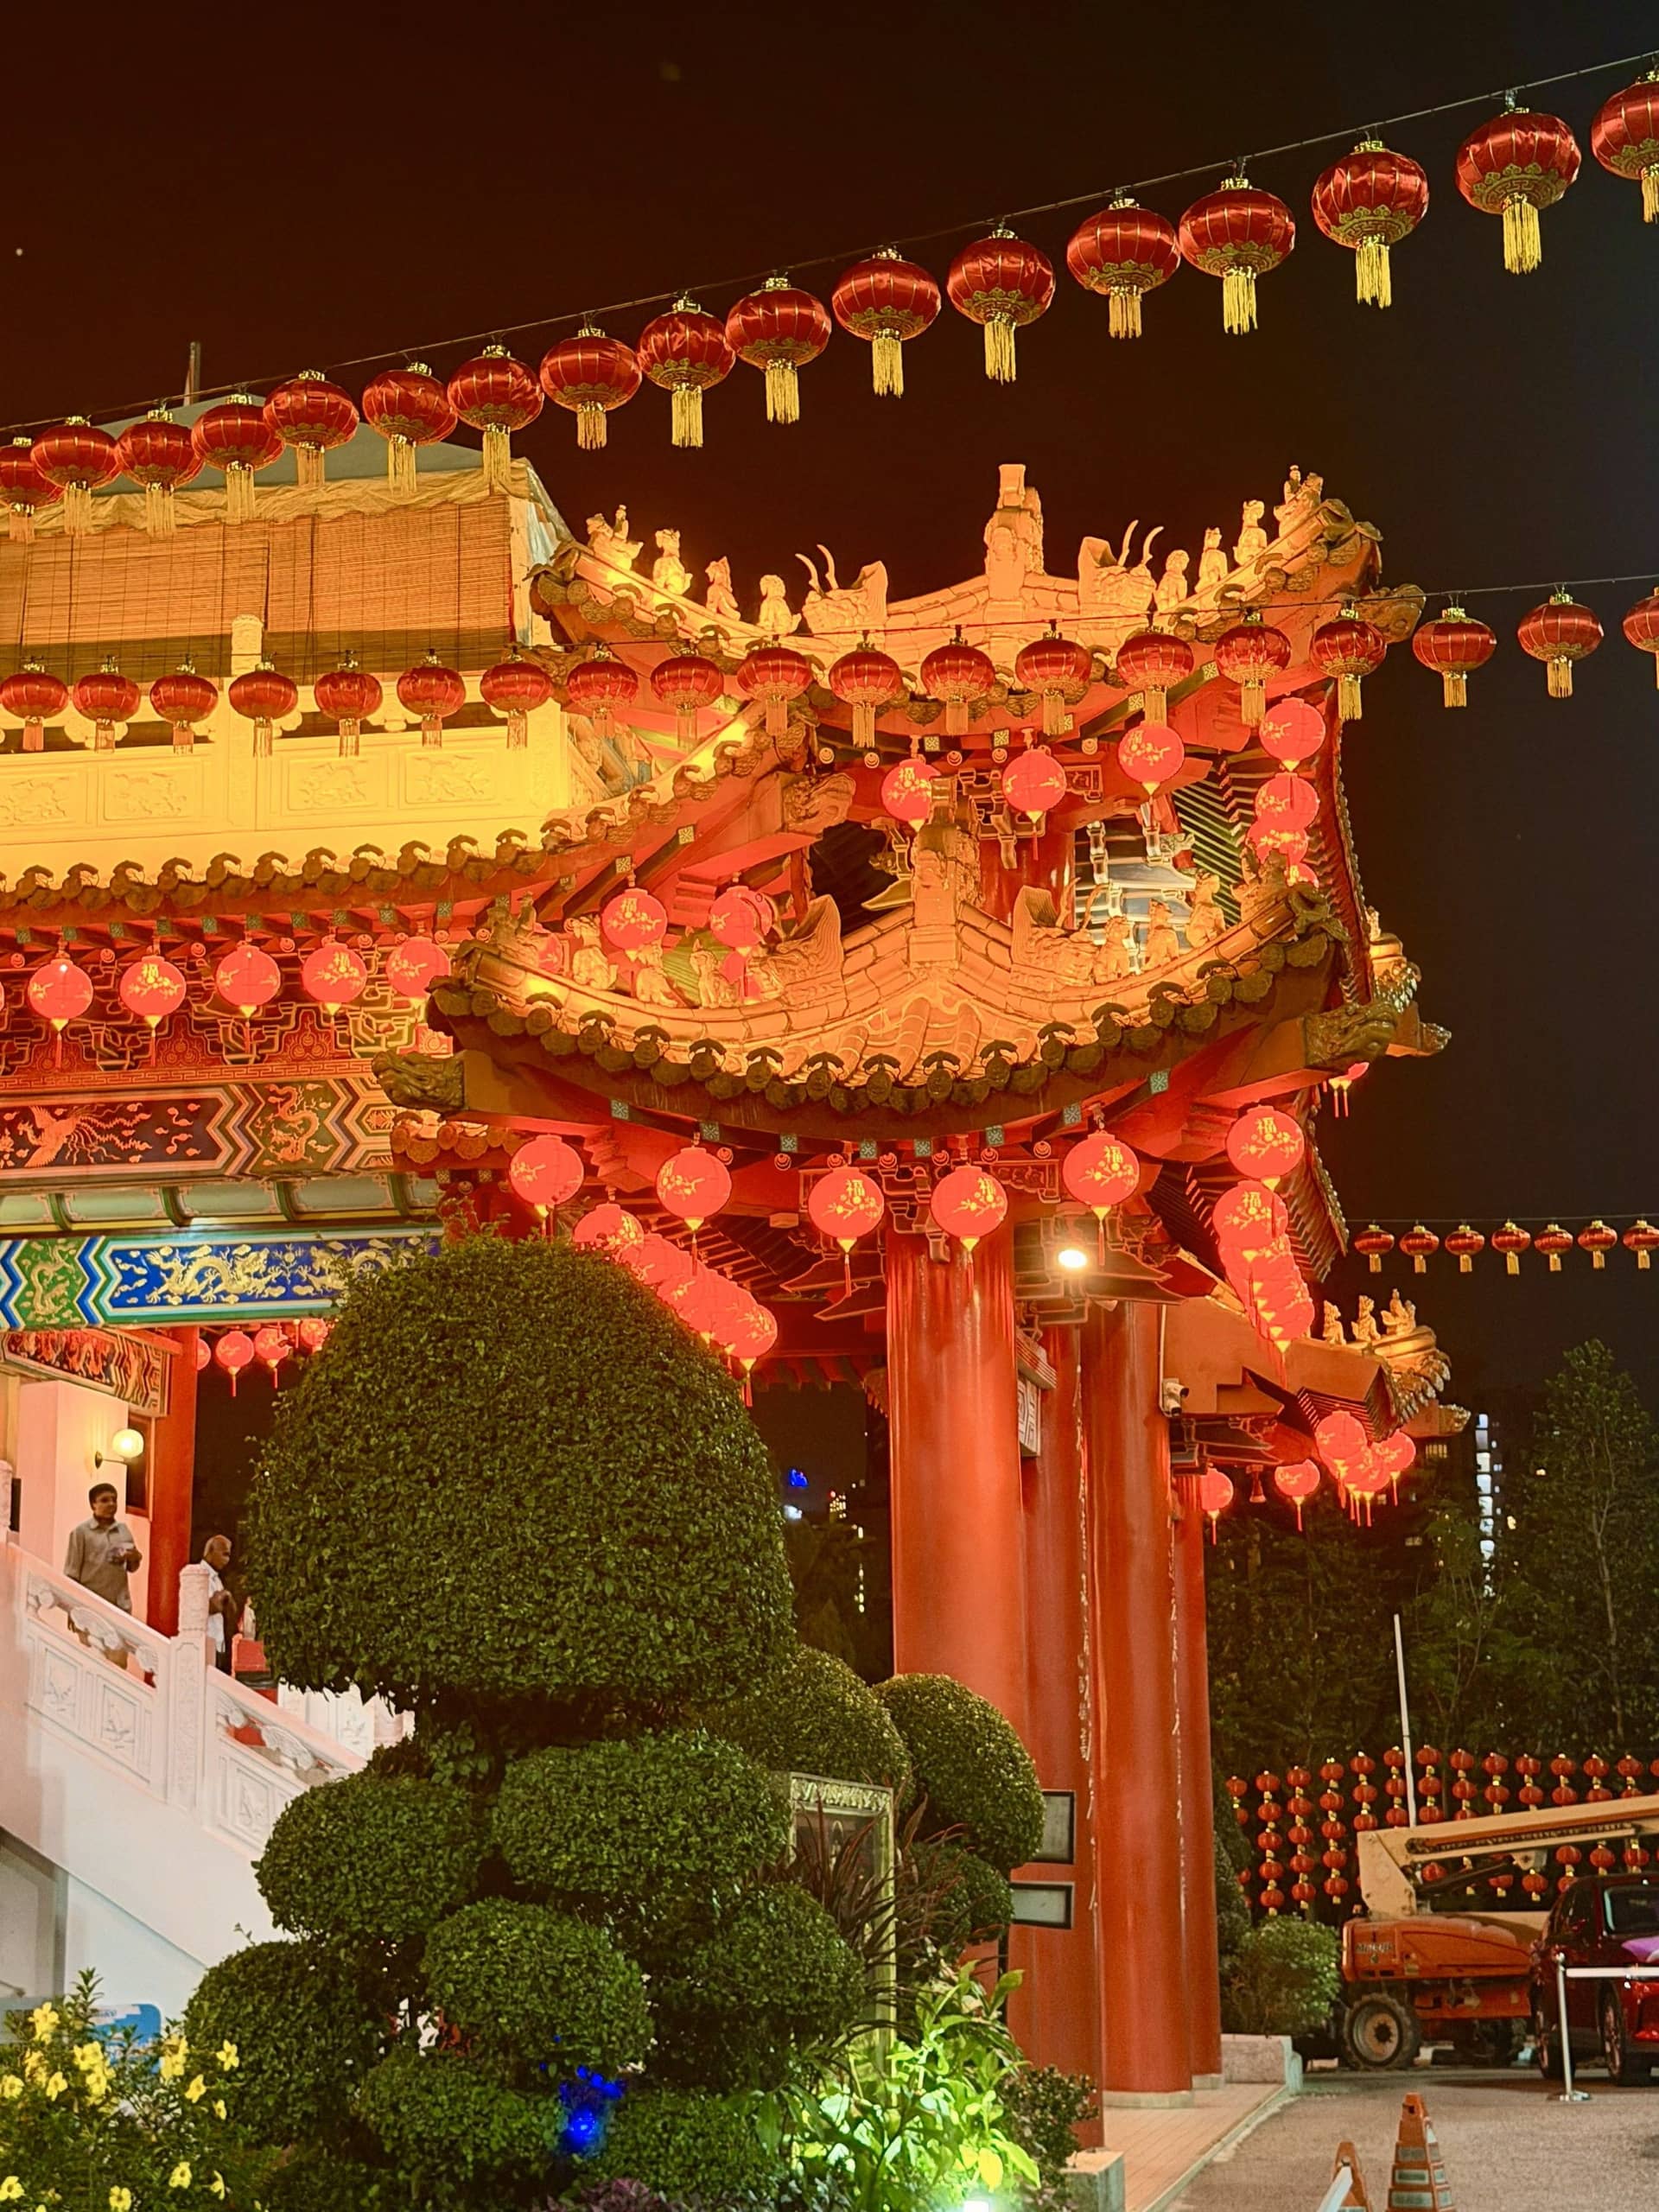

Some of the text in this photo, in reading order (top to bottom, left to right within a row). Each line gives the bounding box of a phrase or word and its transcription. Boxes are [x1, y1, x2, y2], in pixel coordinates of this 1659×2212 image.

[1256, 1117, 1277, 1134] 福
[1103, 1146, 1123, 1163] 福
[846, 1179, 864, 1196] 福
[1242, 1192, 1262, 1208] 福
